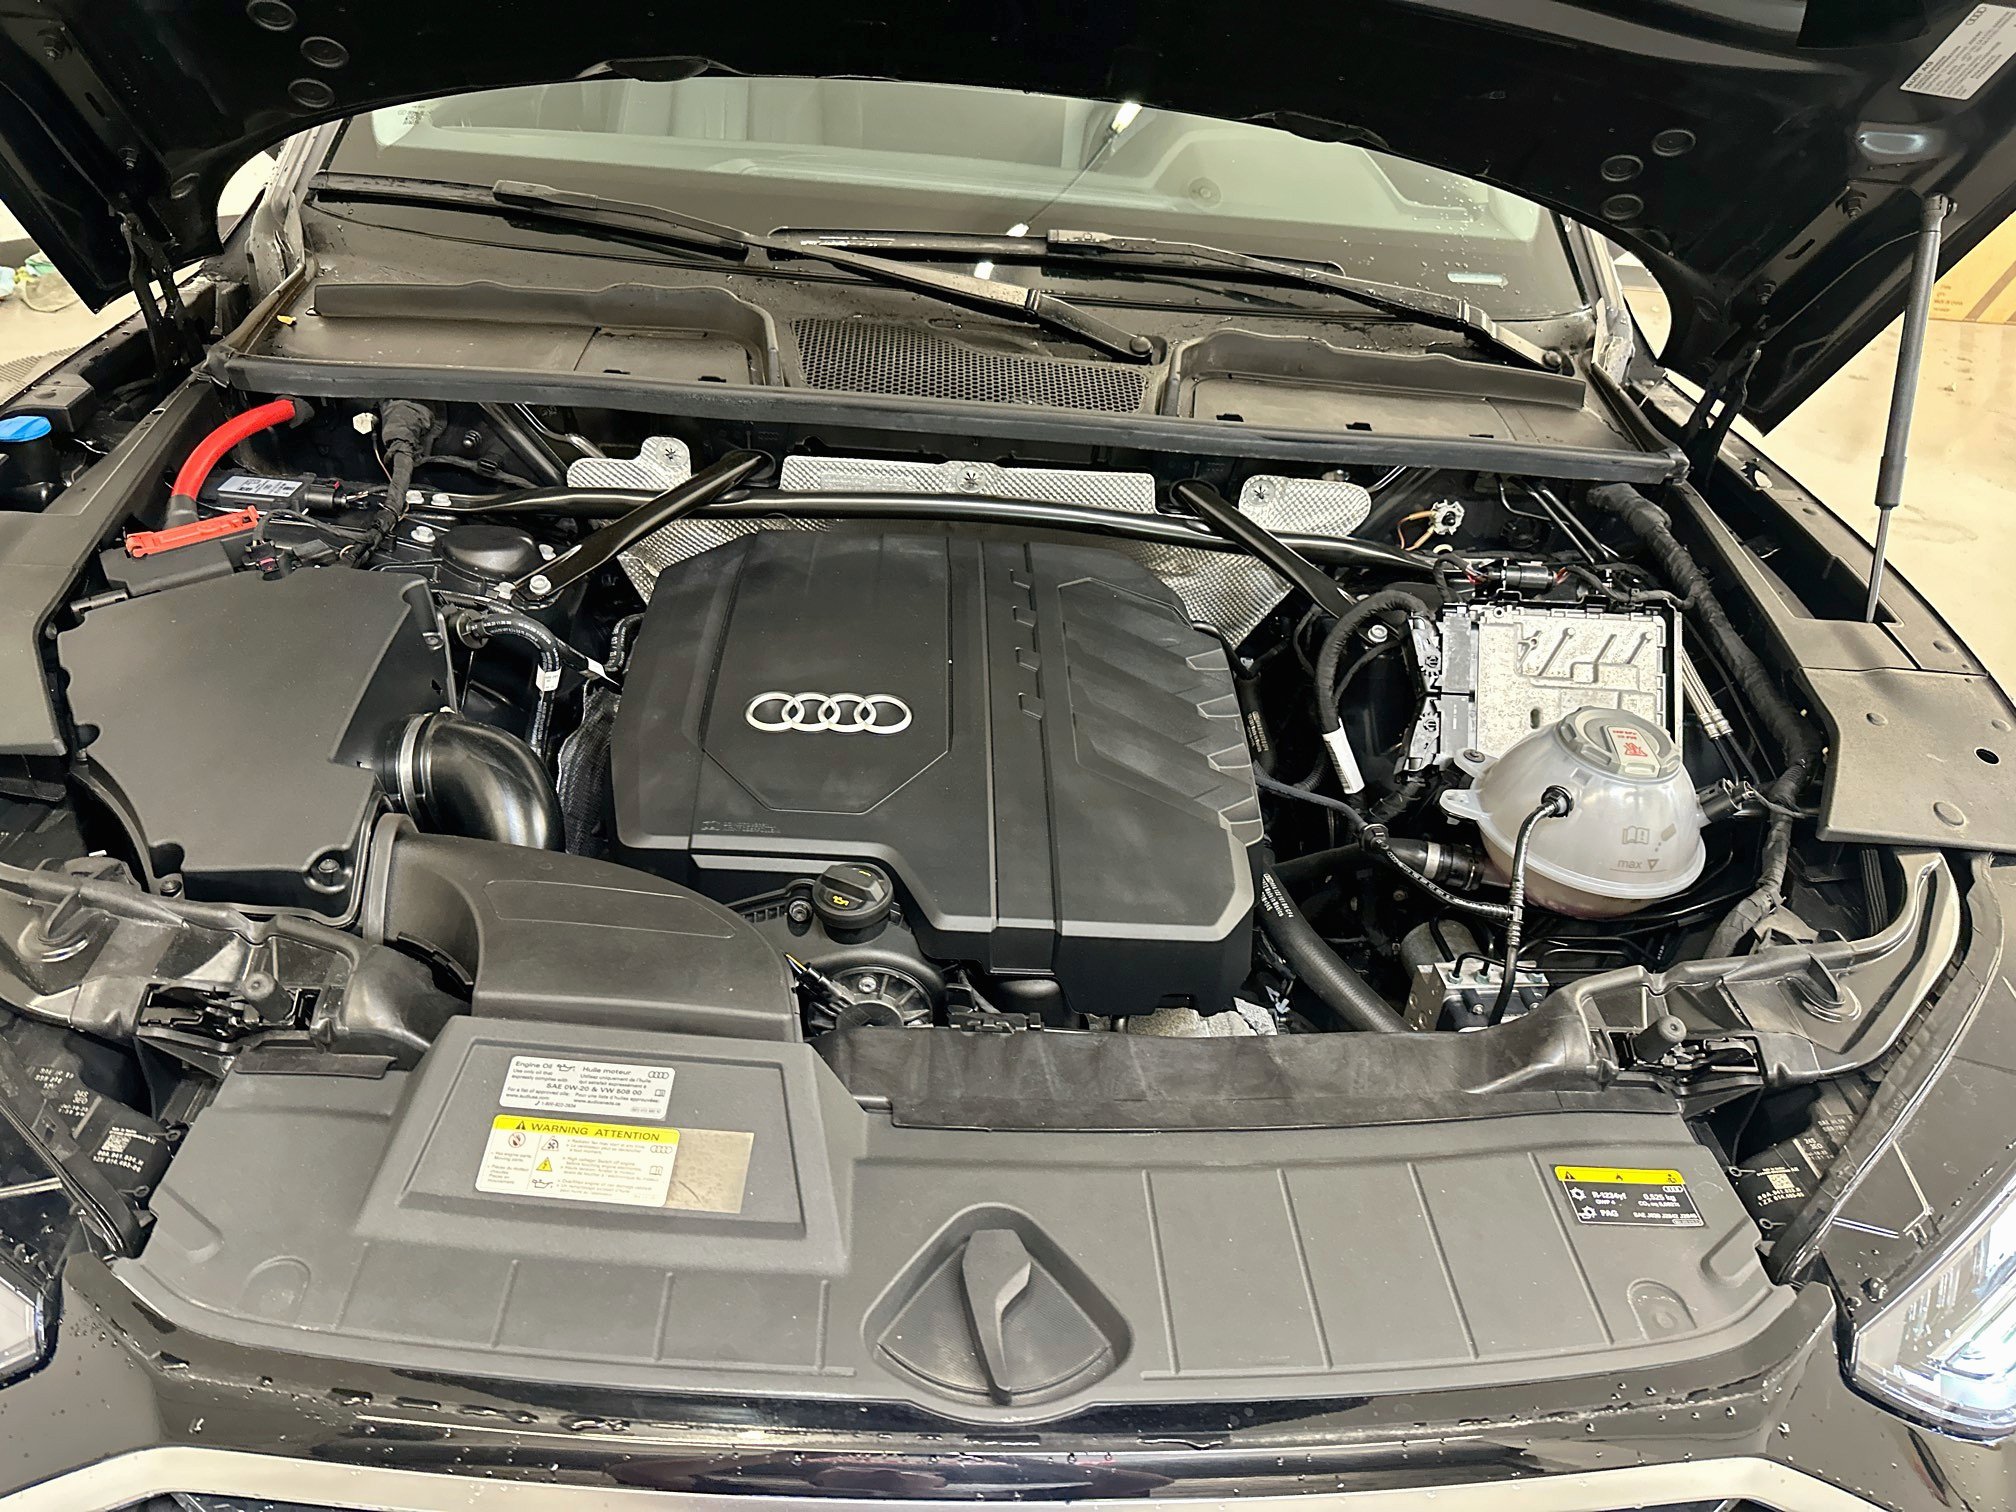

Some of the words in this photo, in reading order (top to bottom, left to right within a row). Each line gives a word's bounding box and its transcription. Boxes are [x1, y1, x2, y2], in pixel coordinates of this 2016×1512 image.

[1617, 859, 1643, 869] max
[564, 1084, 590, 1092] 0W-20
[531, 1122, 589, 1136] WARNING
[594, 1129, 660, 1141] ATTENTION
[1665, 1194, 1677, 1202] kg
[1599, 1209, 1619, 1218] PAG
